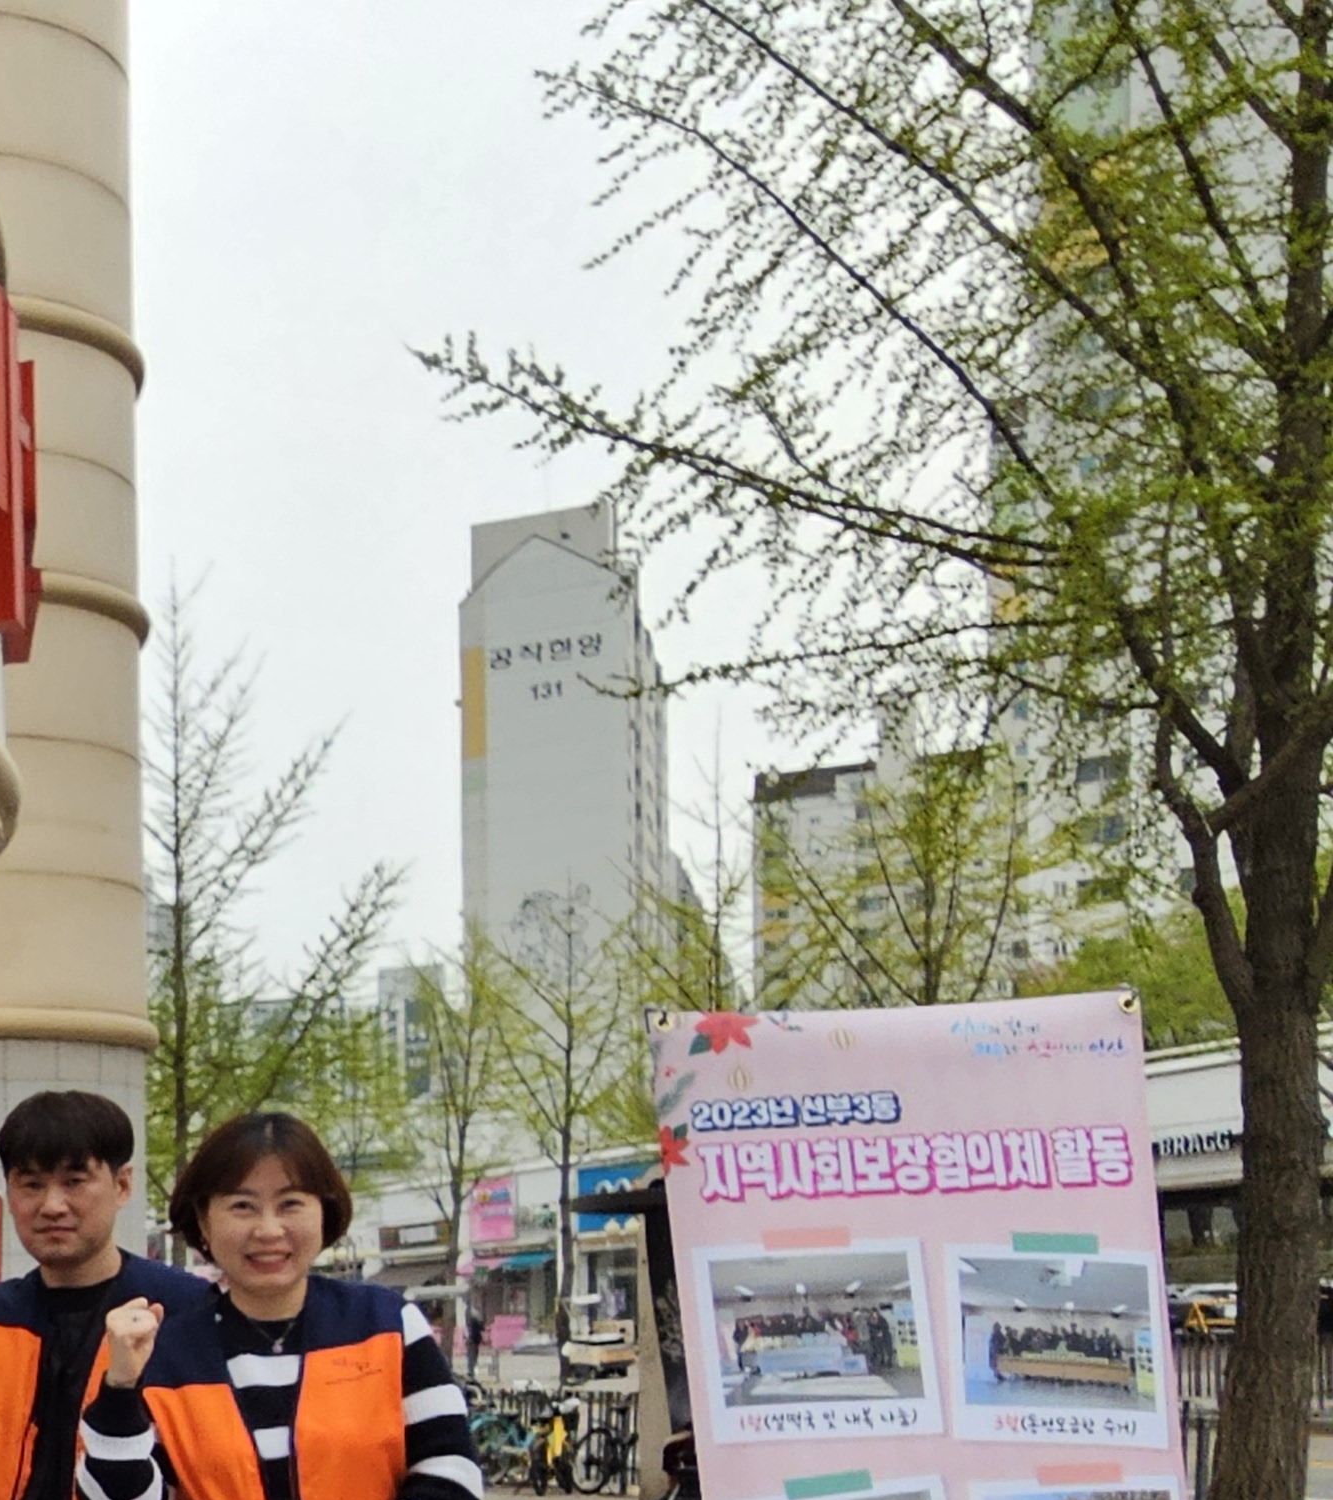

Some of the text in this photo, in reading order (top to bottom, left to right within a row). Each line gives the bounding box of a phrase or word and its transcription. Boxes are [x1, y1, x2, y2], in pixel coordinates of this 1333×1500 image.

[530, 679, 563, 701] 131
[691, 1091, 901, 1131] 2023년 선부3동
[697, 1125, 1132, 1202] 지역사회보장협의체 활동
